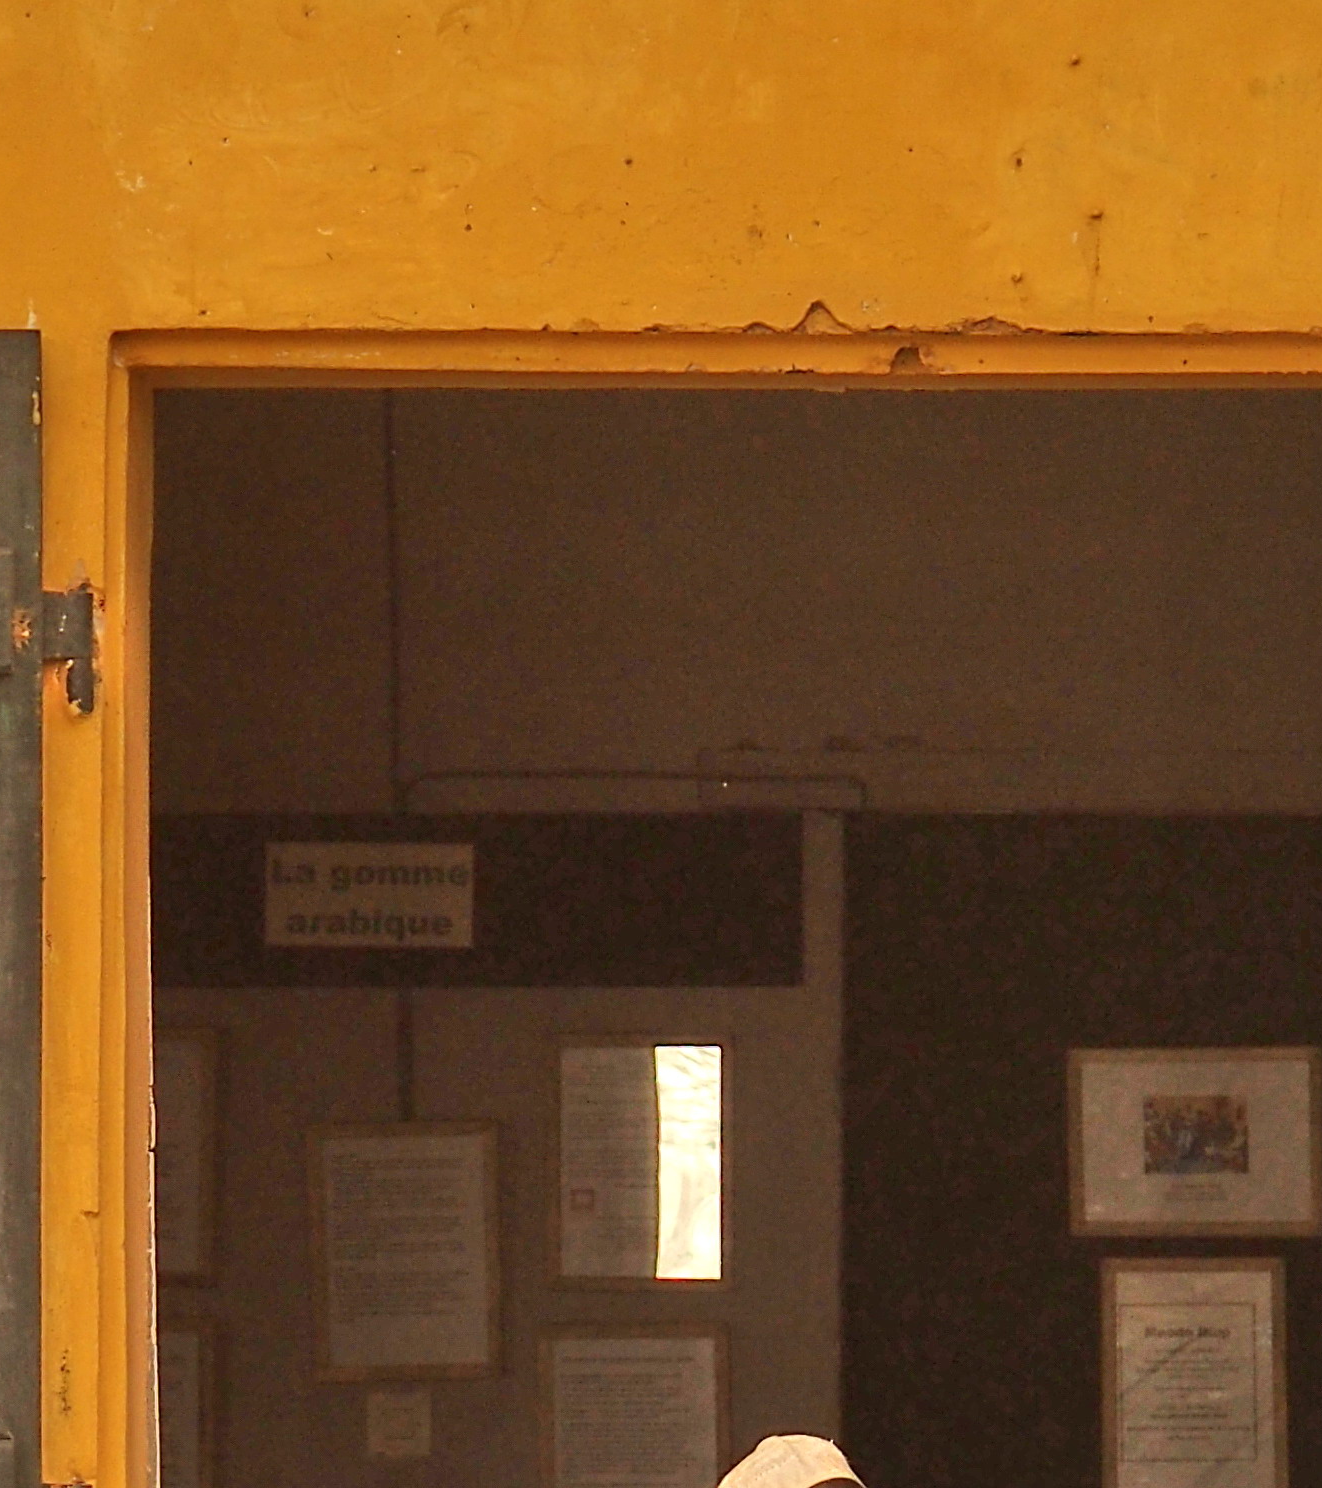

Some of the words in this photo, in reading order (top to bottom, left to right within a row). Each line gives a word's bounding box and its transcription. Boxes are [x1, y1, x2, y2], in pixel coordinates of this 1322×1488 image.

[271, 857, 317, 885] La
[330, 864, 470, 893] gomme
[286, 908, 454, 942] arabique
